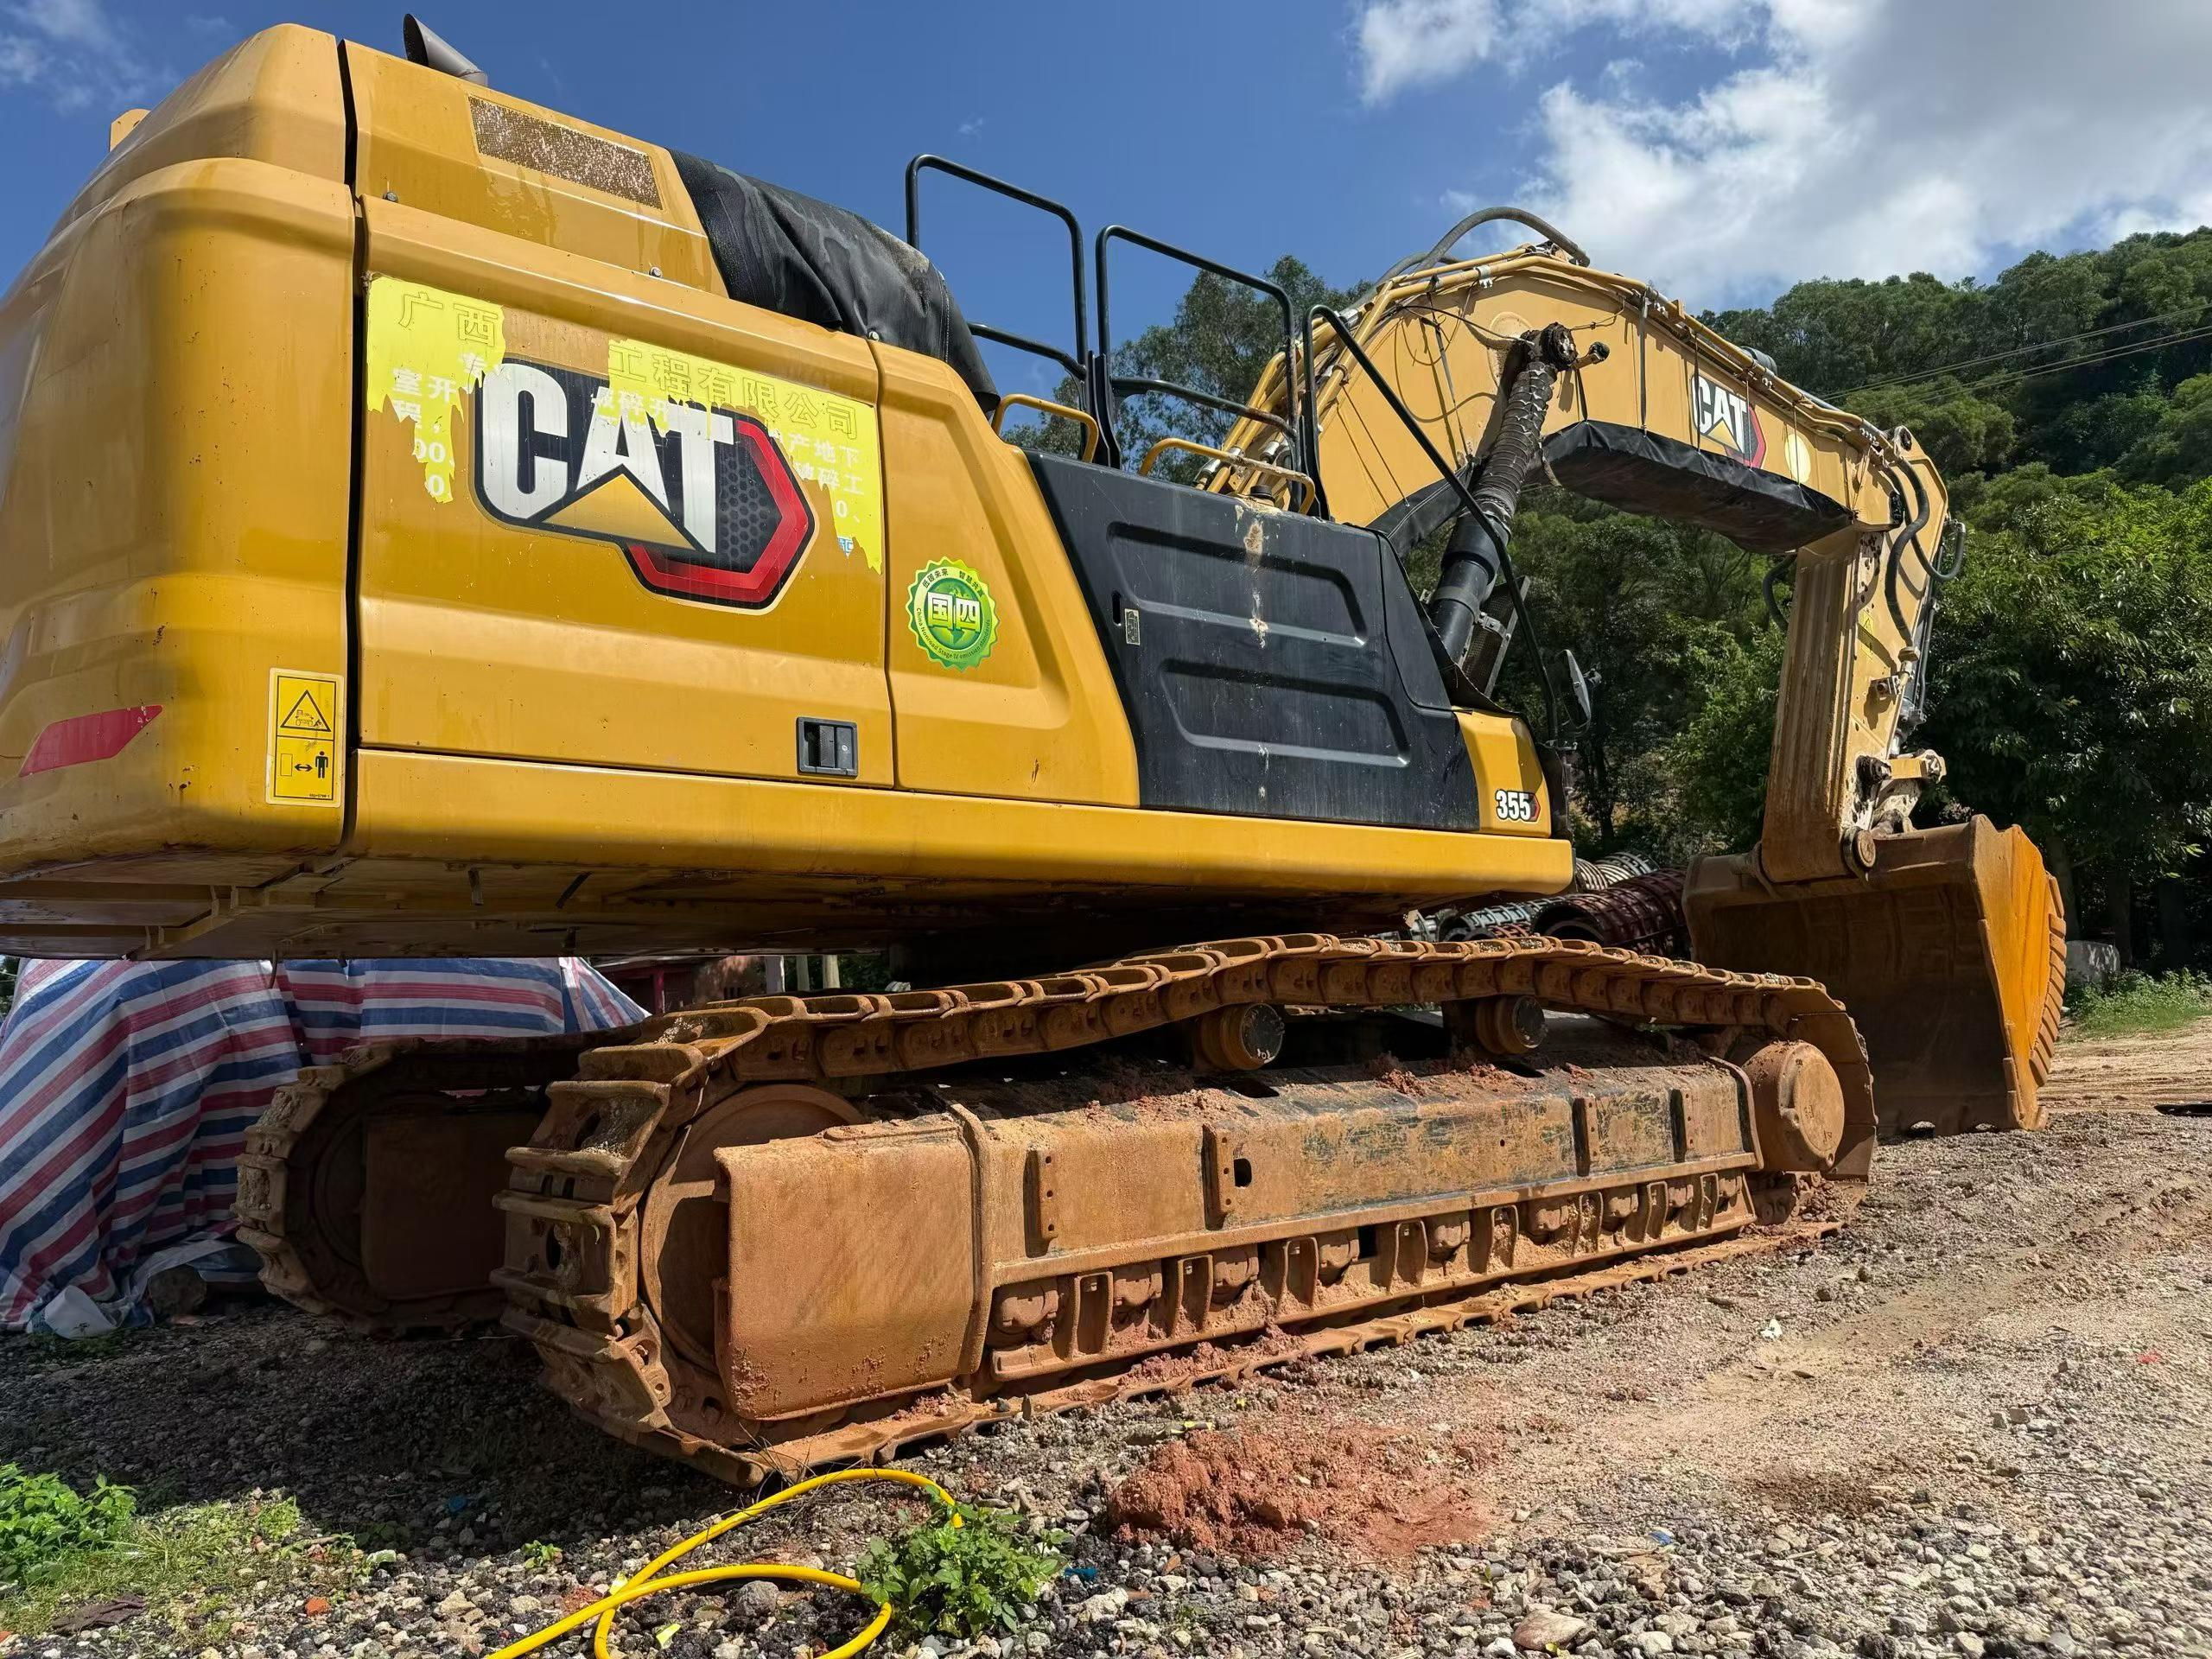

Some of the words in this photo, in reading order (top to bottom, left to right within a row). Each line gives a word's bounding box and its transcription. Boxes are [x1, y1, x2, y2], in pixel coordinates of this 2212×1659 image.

[398, 291, 499, 347] 广西
[608, 344, 858, 440] 工程有限公司
[1691, 374, 1748, 454] CAT
[481, 361, 734, 554] CAT
[927, 591, 981, 632] 国四
[938, 647, 953, 659] Stage
[1495, 789, 1531, 822] 355
